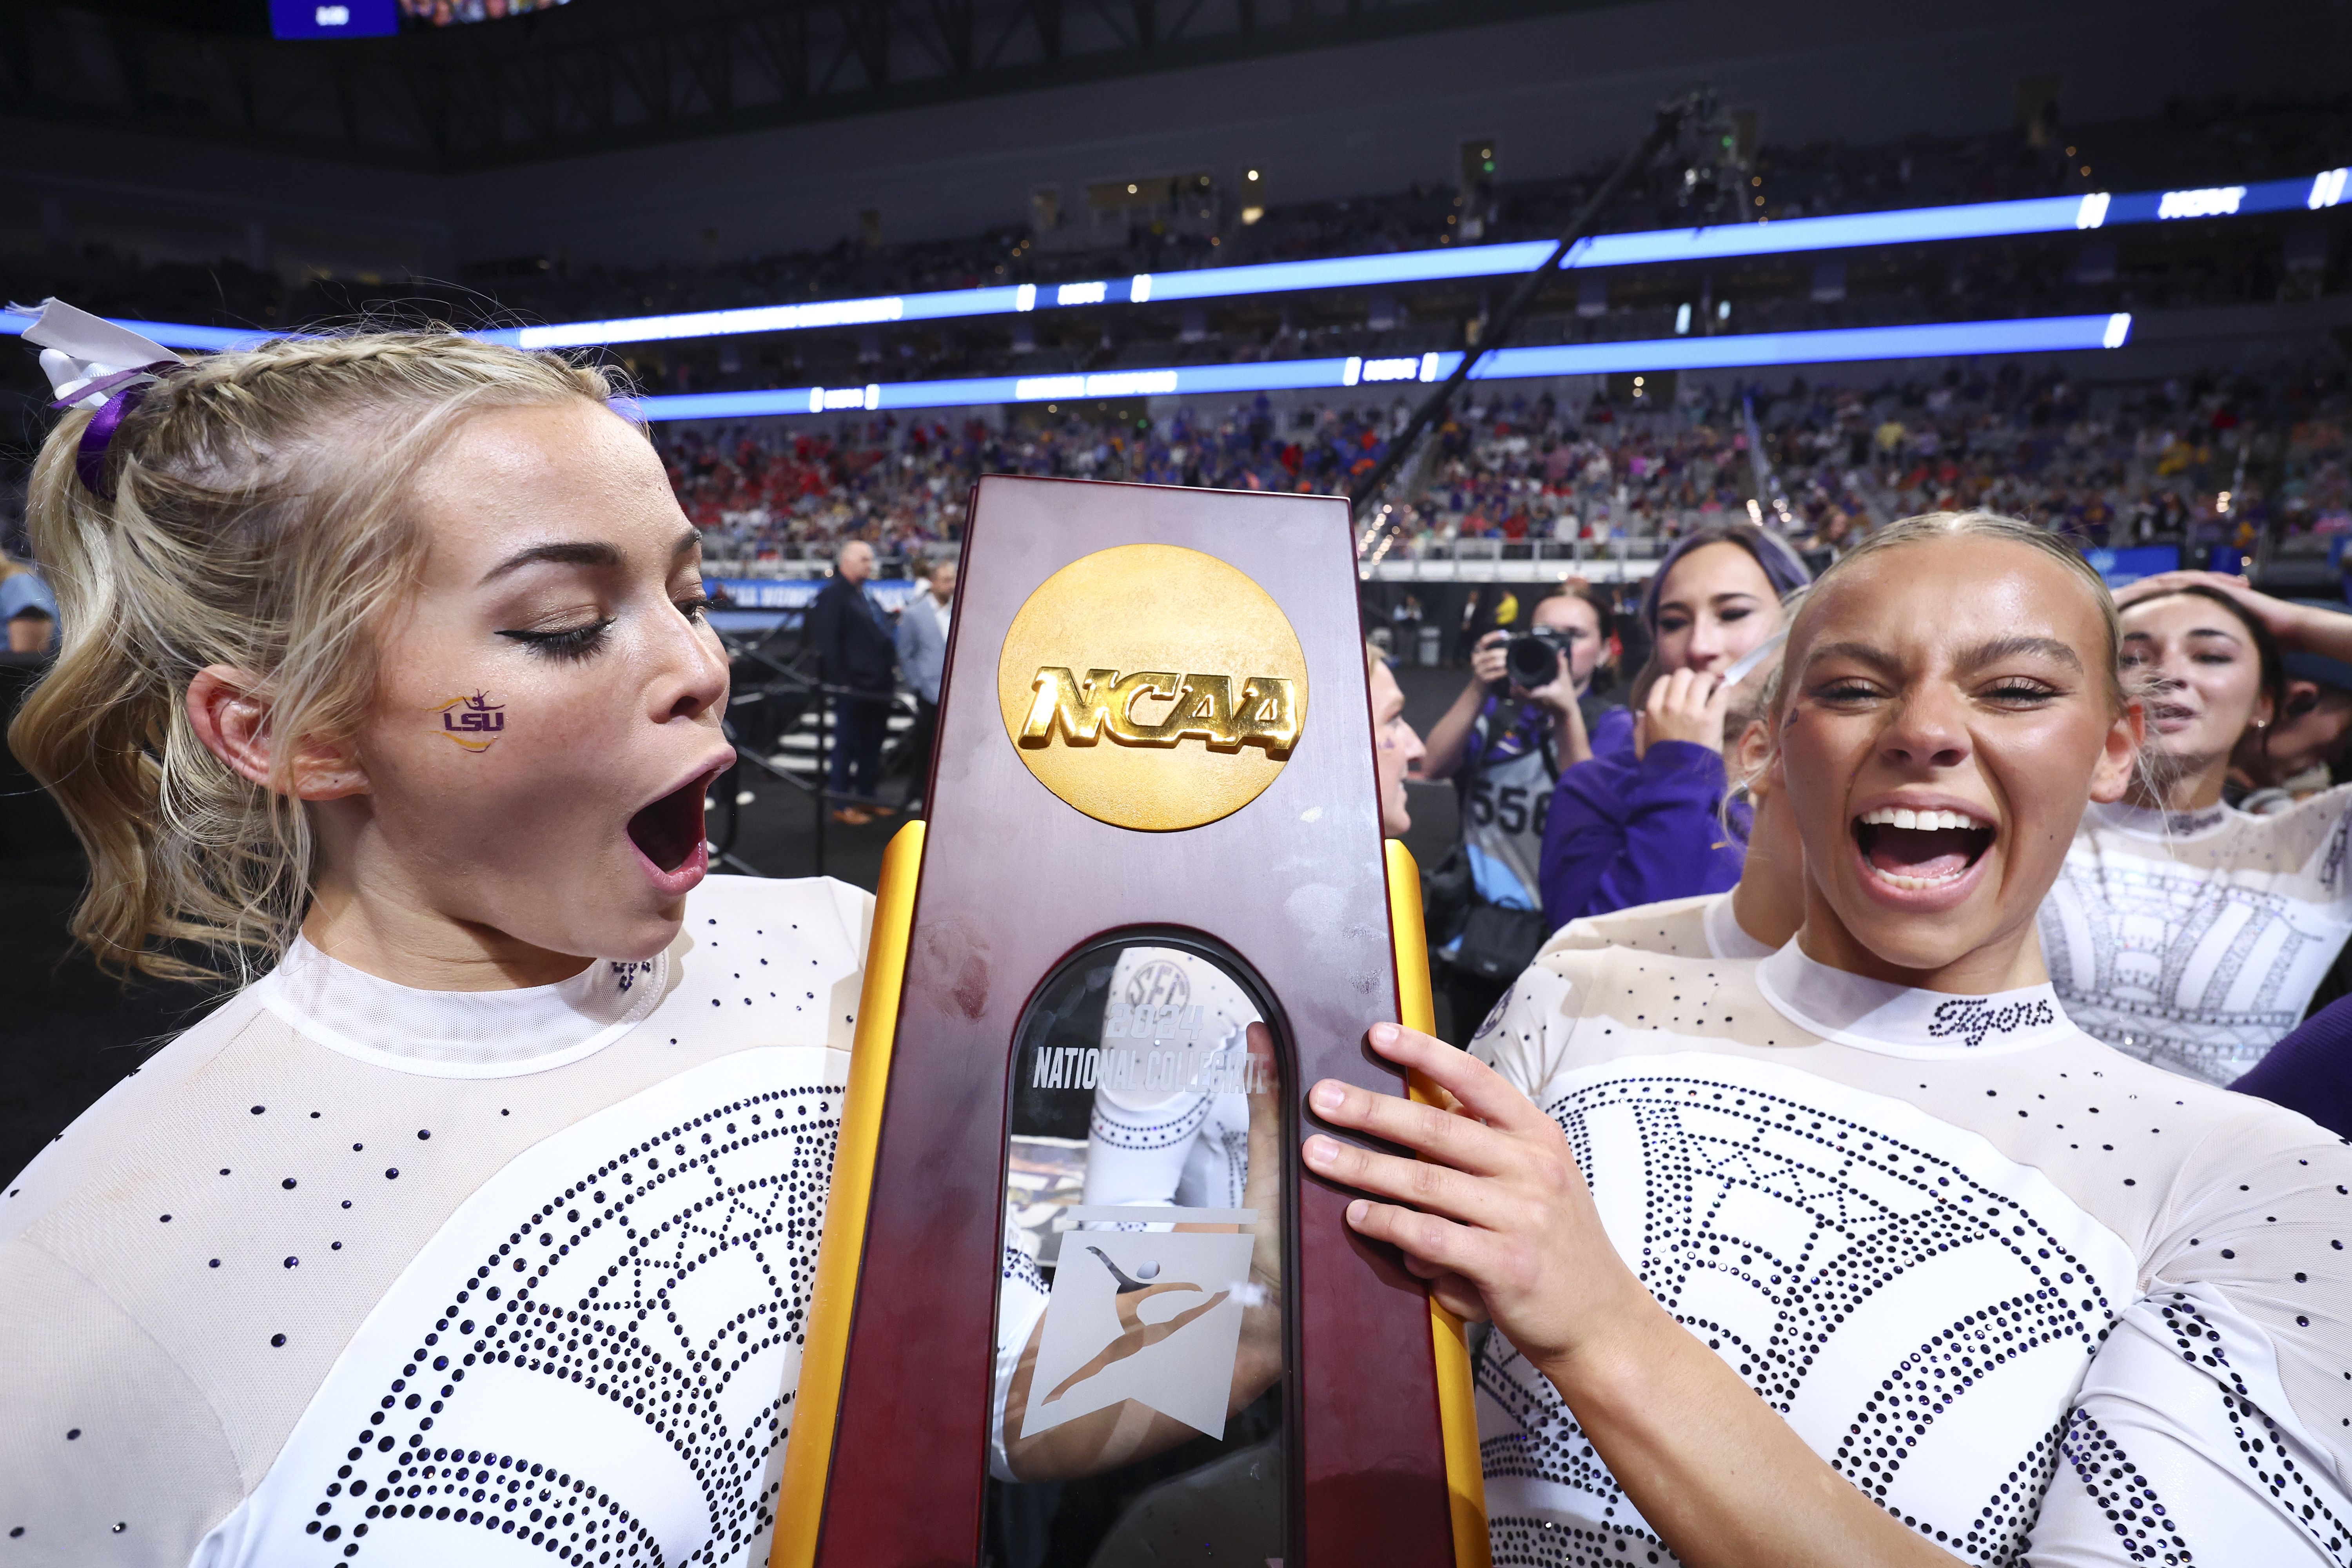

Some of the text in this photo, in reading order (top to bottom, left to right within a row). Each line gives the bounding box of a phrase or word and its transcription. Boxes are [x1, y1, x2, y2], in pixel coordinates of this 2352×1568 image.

[443, 712, 504, 731] LSU
[1018, 666, 1300, 761] NCAA
[1105, 1002, 1204, 1041] 2024
[1928, 998, 2054, 1047] Tigers
[1032, 1046, 1270, 1094] NATIONAL COLLEGIATE
